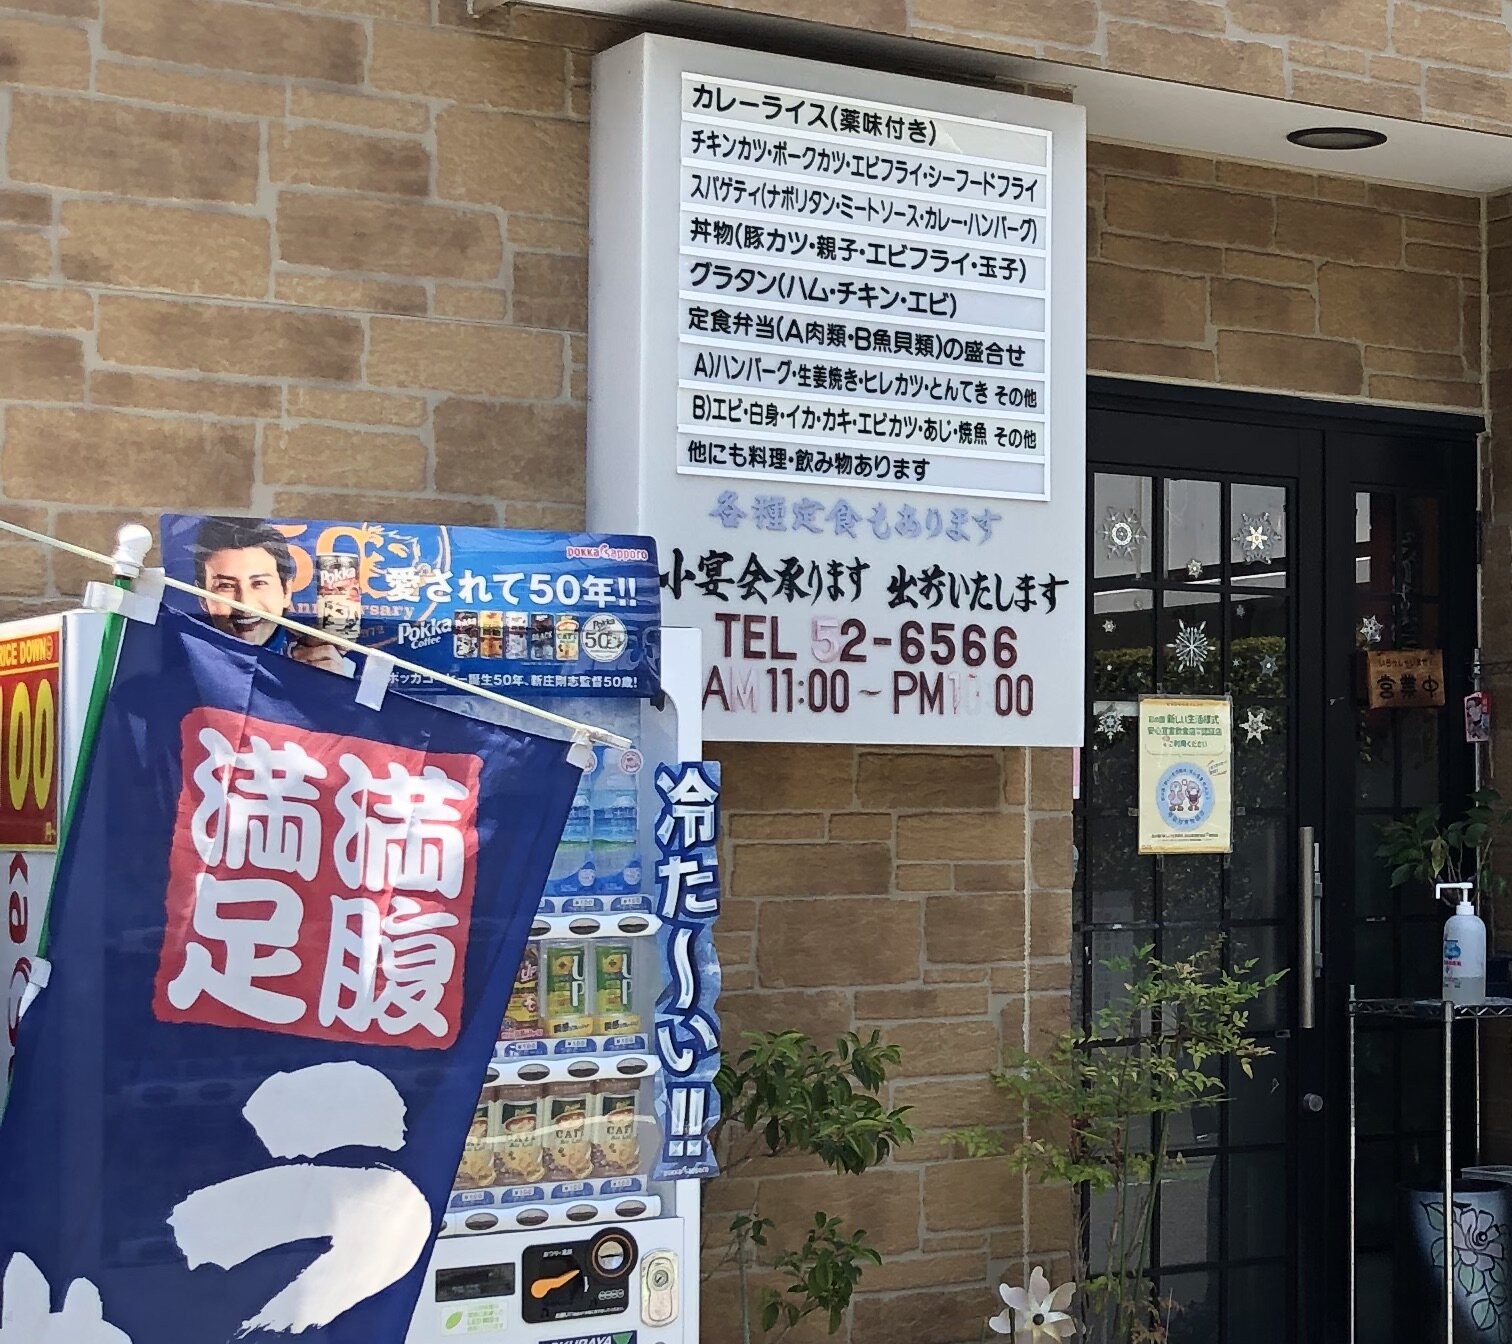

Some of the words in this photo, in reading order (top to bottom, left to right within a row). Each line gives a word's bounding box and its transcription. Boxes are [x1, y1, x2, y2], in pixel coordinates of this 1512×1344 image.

[691, 84, 937, 147] カレーライス(薬味付き)
[689, 217, 1027, 284] 丼物(豚カツ・親子・エビフライ・玉子)
[689, 262, 957, 320] グラタン(ハム・チキン・エビ)
[688, 306, 1027, 367] 定食弁当(A肉類・B魚貝類)の盛合せ
[693, 352, 988, 404] A)ハンバーグ・生姜焼き・ヒレカツ・とんてき
[994, 385, 1038, 409] その他
[692, 394, 988, 446] B)エビ・白身・イカ・カキ・エビカツ・あじ・焼魚
[994, 427, 1037, 450] その他
[688, 439, 931, 482] 他にも料理・飲み物あります
[708, 489, 1004, 546] 各種定食もあります
[385, 567, 638, 609] 愛されて50年!!
[660, 547, 871, 604] 小宴会承ります
[397, 617, 452, 645] Pokka
[714, 612, 798, 661] TEL
[810, 614, 1019, 670] 52-6566
[1376, 674, 1440, 699] 営業中
[0, 678, 55, 812] 00
[167, 727, 328, 1024] 満足
[317, 752, 471, 1039] 満腹
